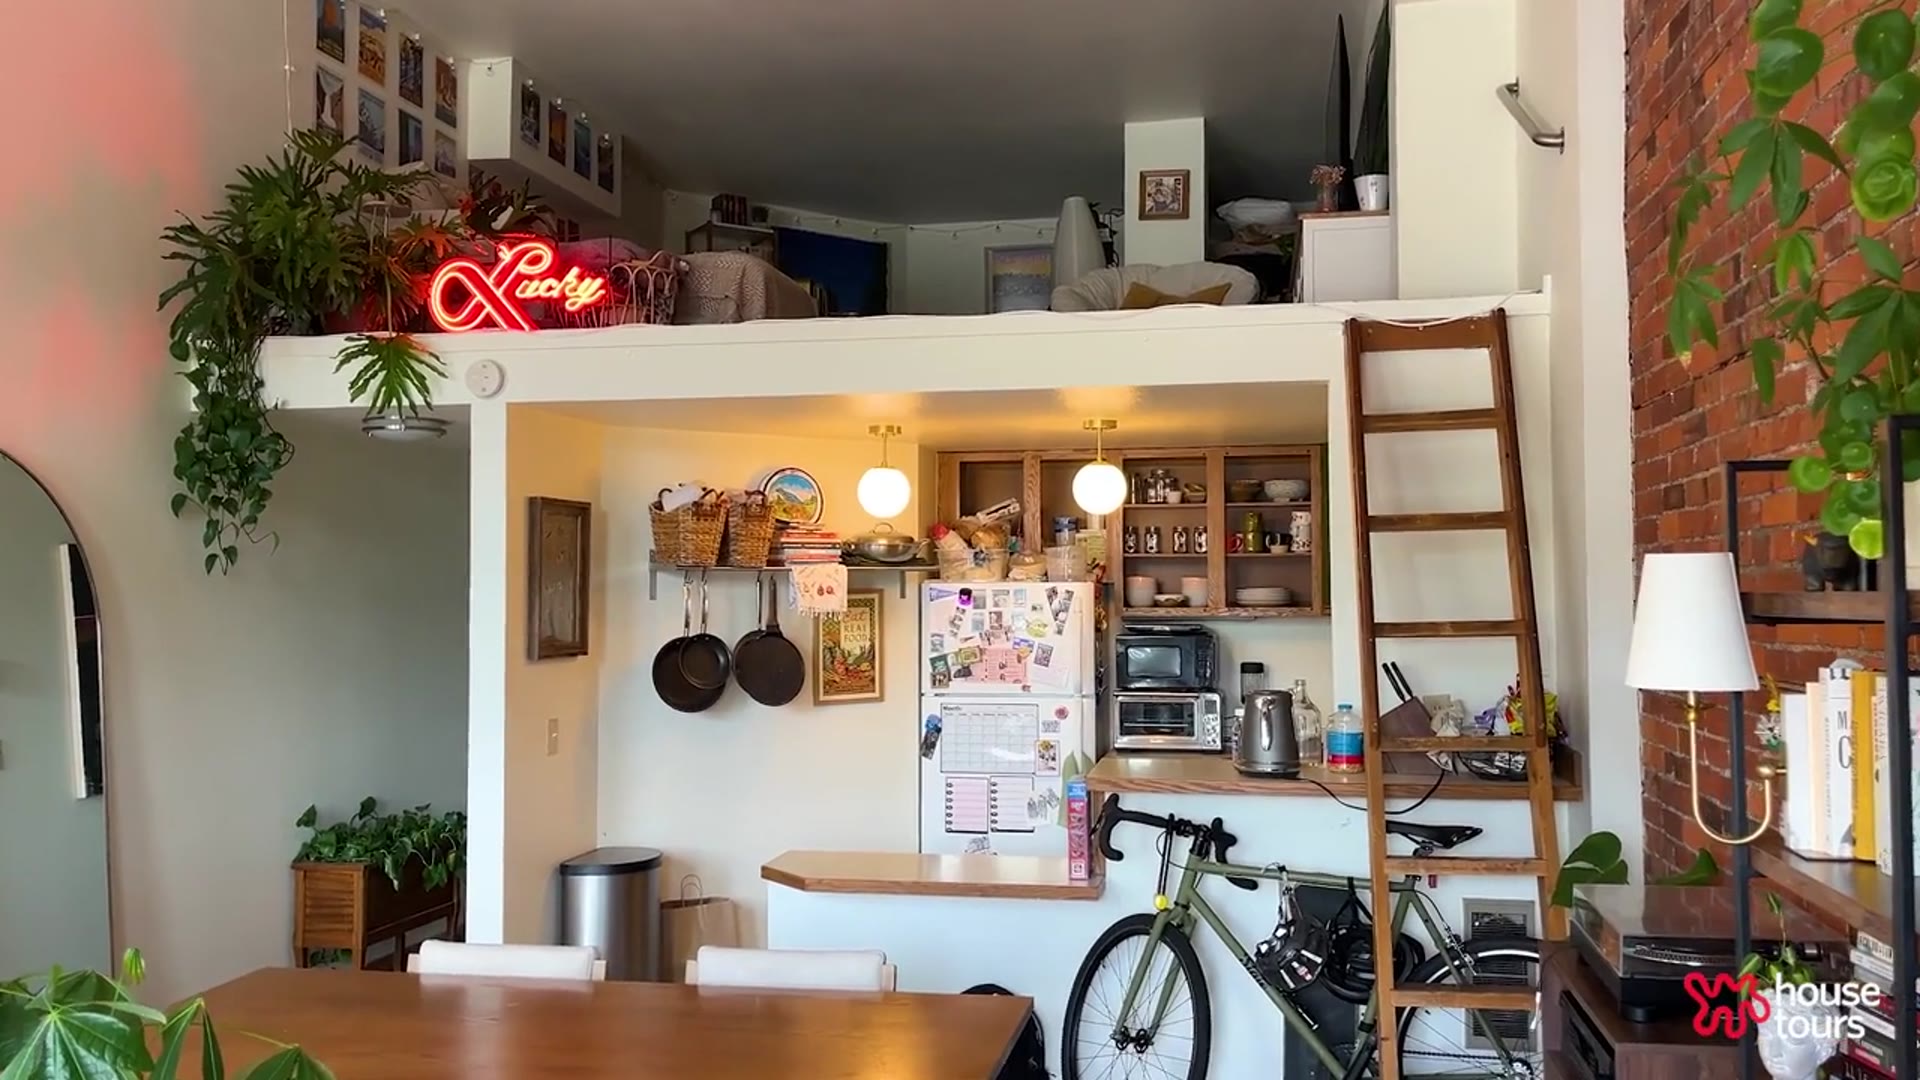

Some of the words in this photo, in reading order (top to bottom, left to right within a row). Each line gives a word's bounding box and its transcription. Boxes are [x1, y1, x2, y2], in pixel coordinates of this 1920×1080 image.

[430, 241, 607, 332] Lucky
[842, 610, 867, 624] Eat
[844, 624, 867, 633] REAL
[844, 633, 868, 643] FOOD
